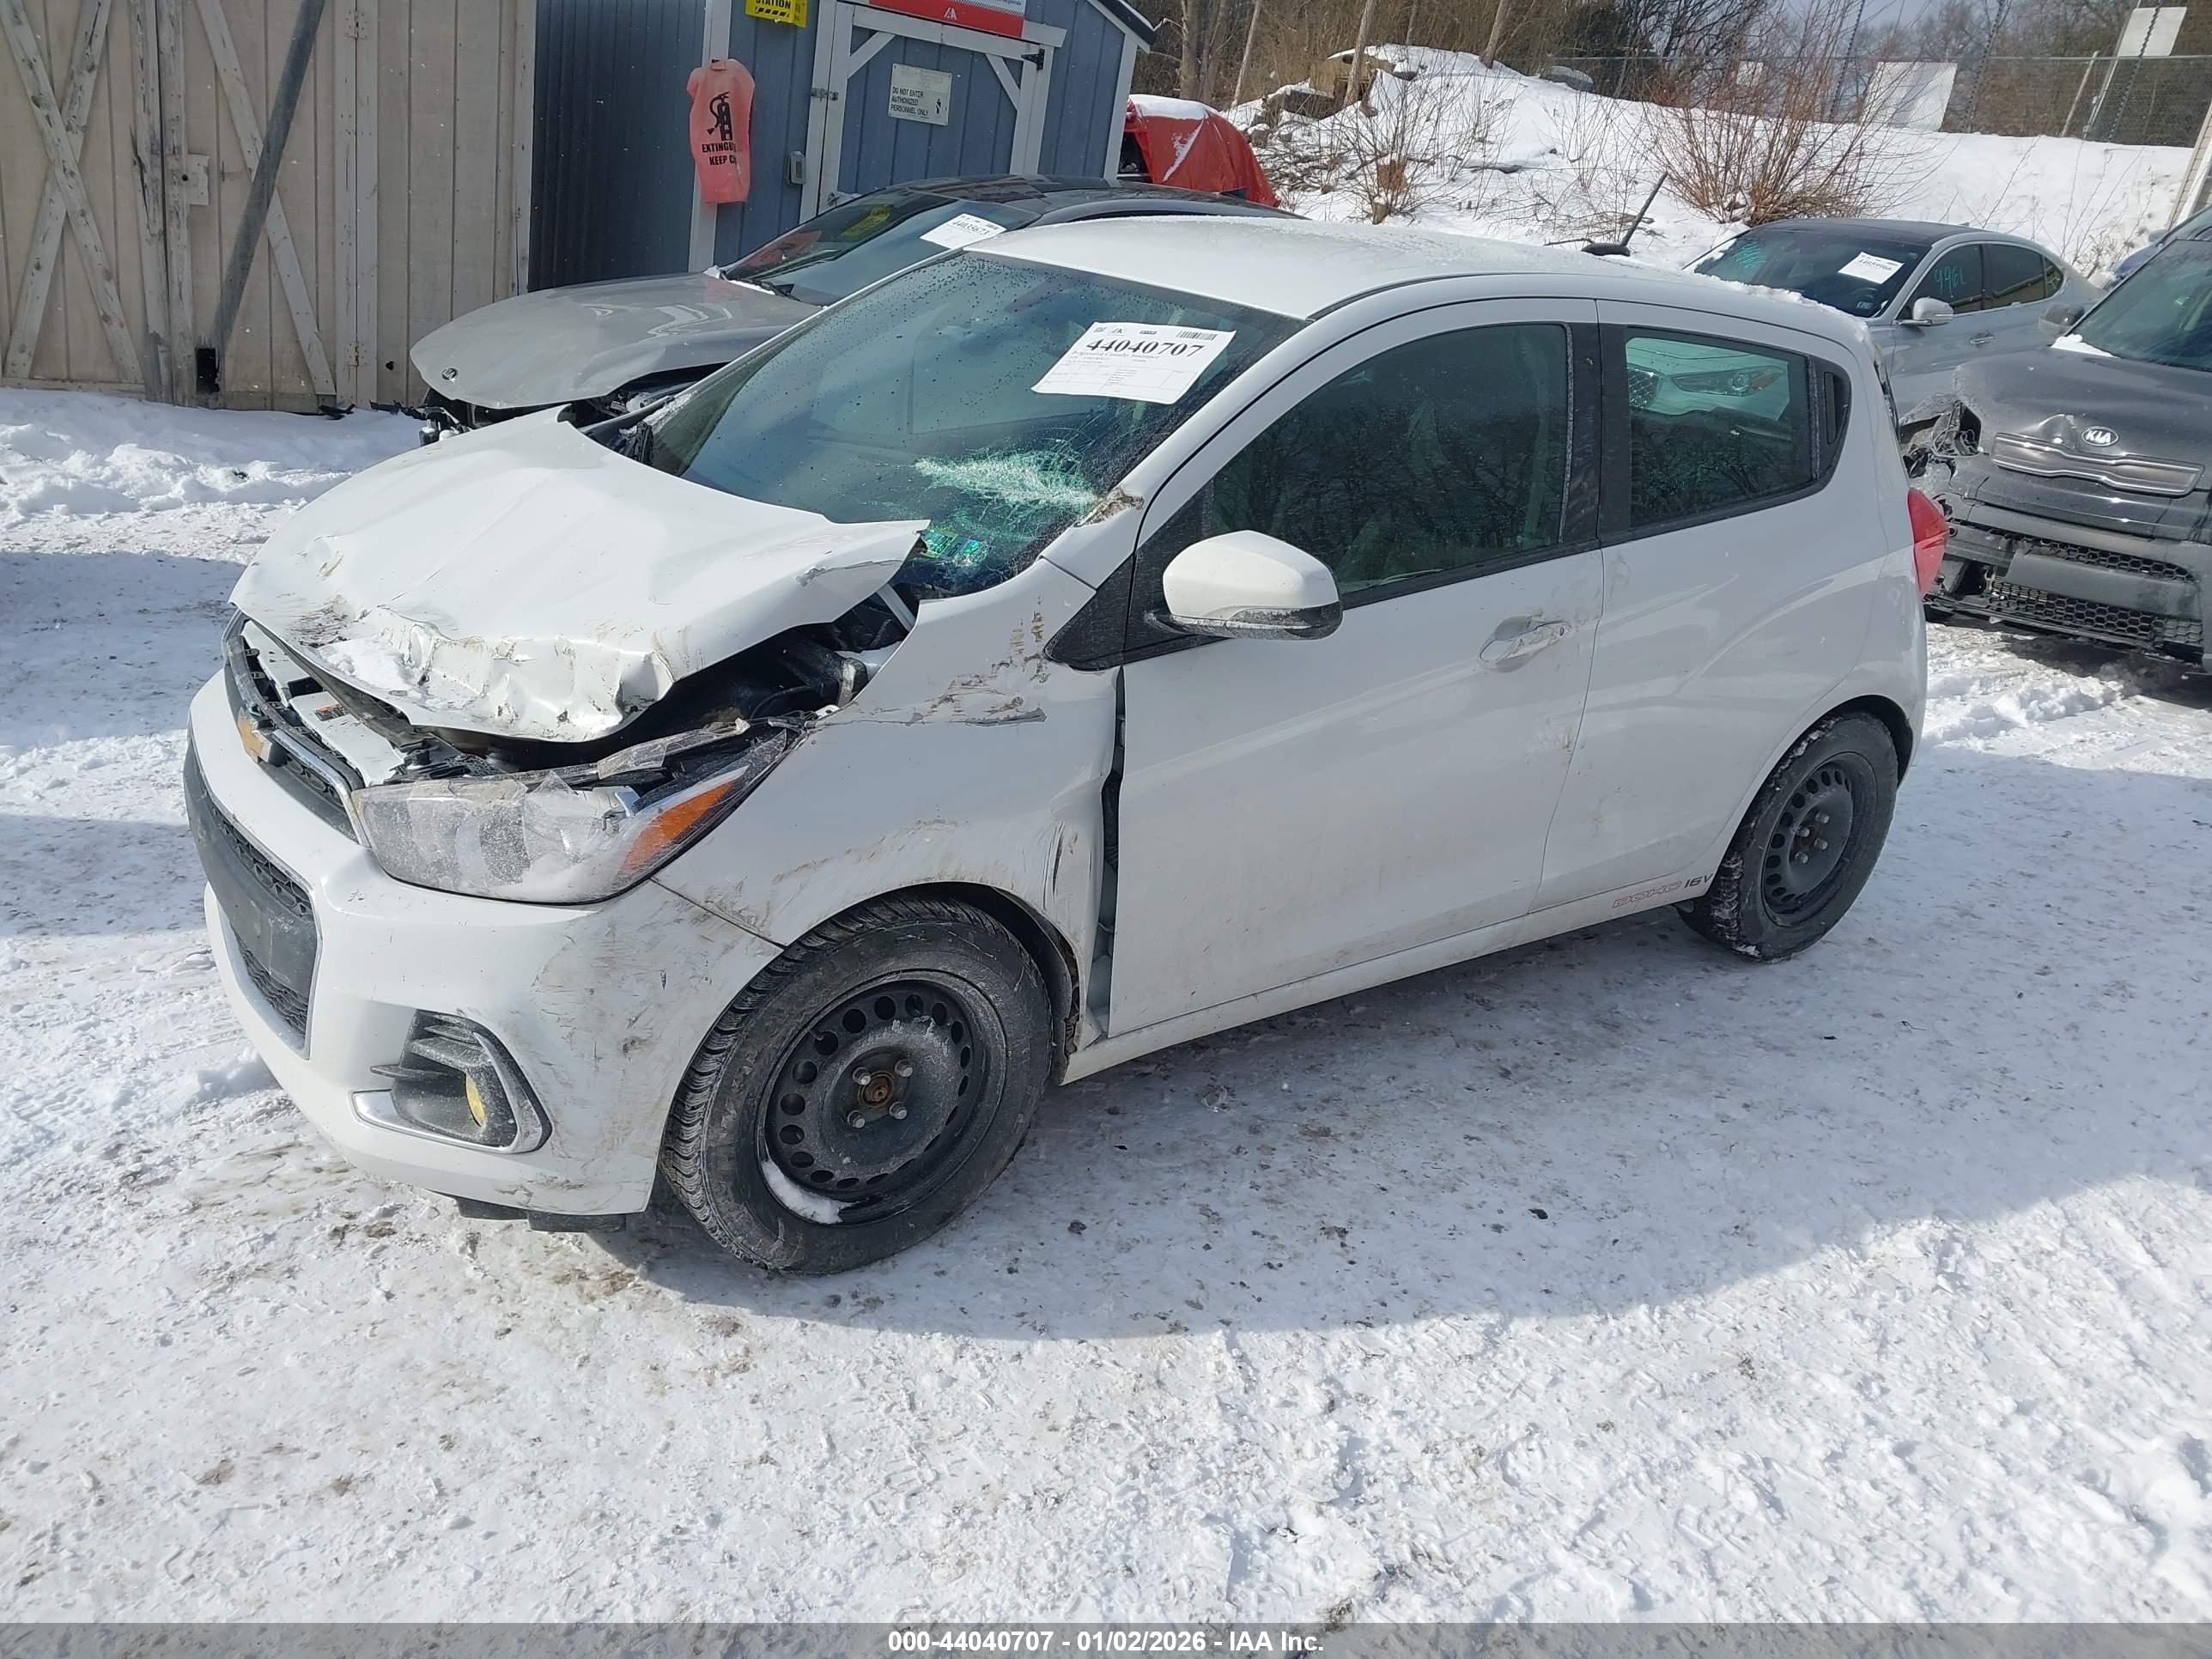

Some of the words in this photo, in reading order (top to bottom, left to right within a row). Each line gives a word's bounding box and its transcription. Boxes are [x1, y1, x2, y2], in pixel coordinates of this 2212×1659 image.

[909, 89, 924, 98] ENTER
[891, 95, 919, 106] AUTHORIZED
[890, 104, 916, 114] PERSONNEL
[709, 155, 727, 166] KEEP
[1086, 338, 1205, 357] 44040707
[2085, 429, 2112, 444] KIA
[1684, 872, 1714, 889] 16V
